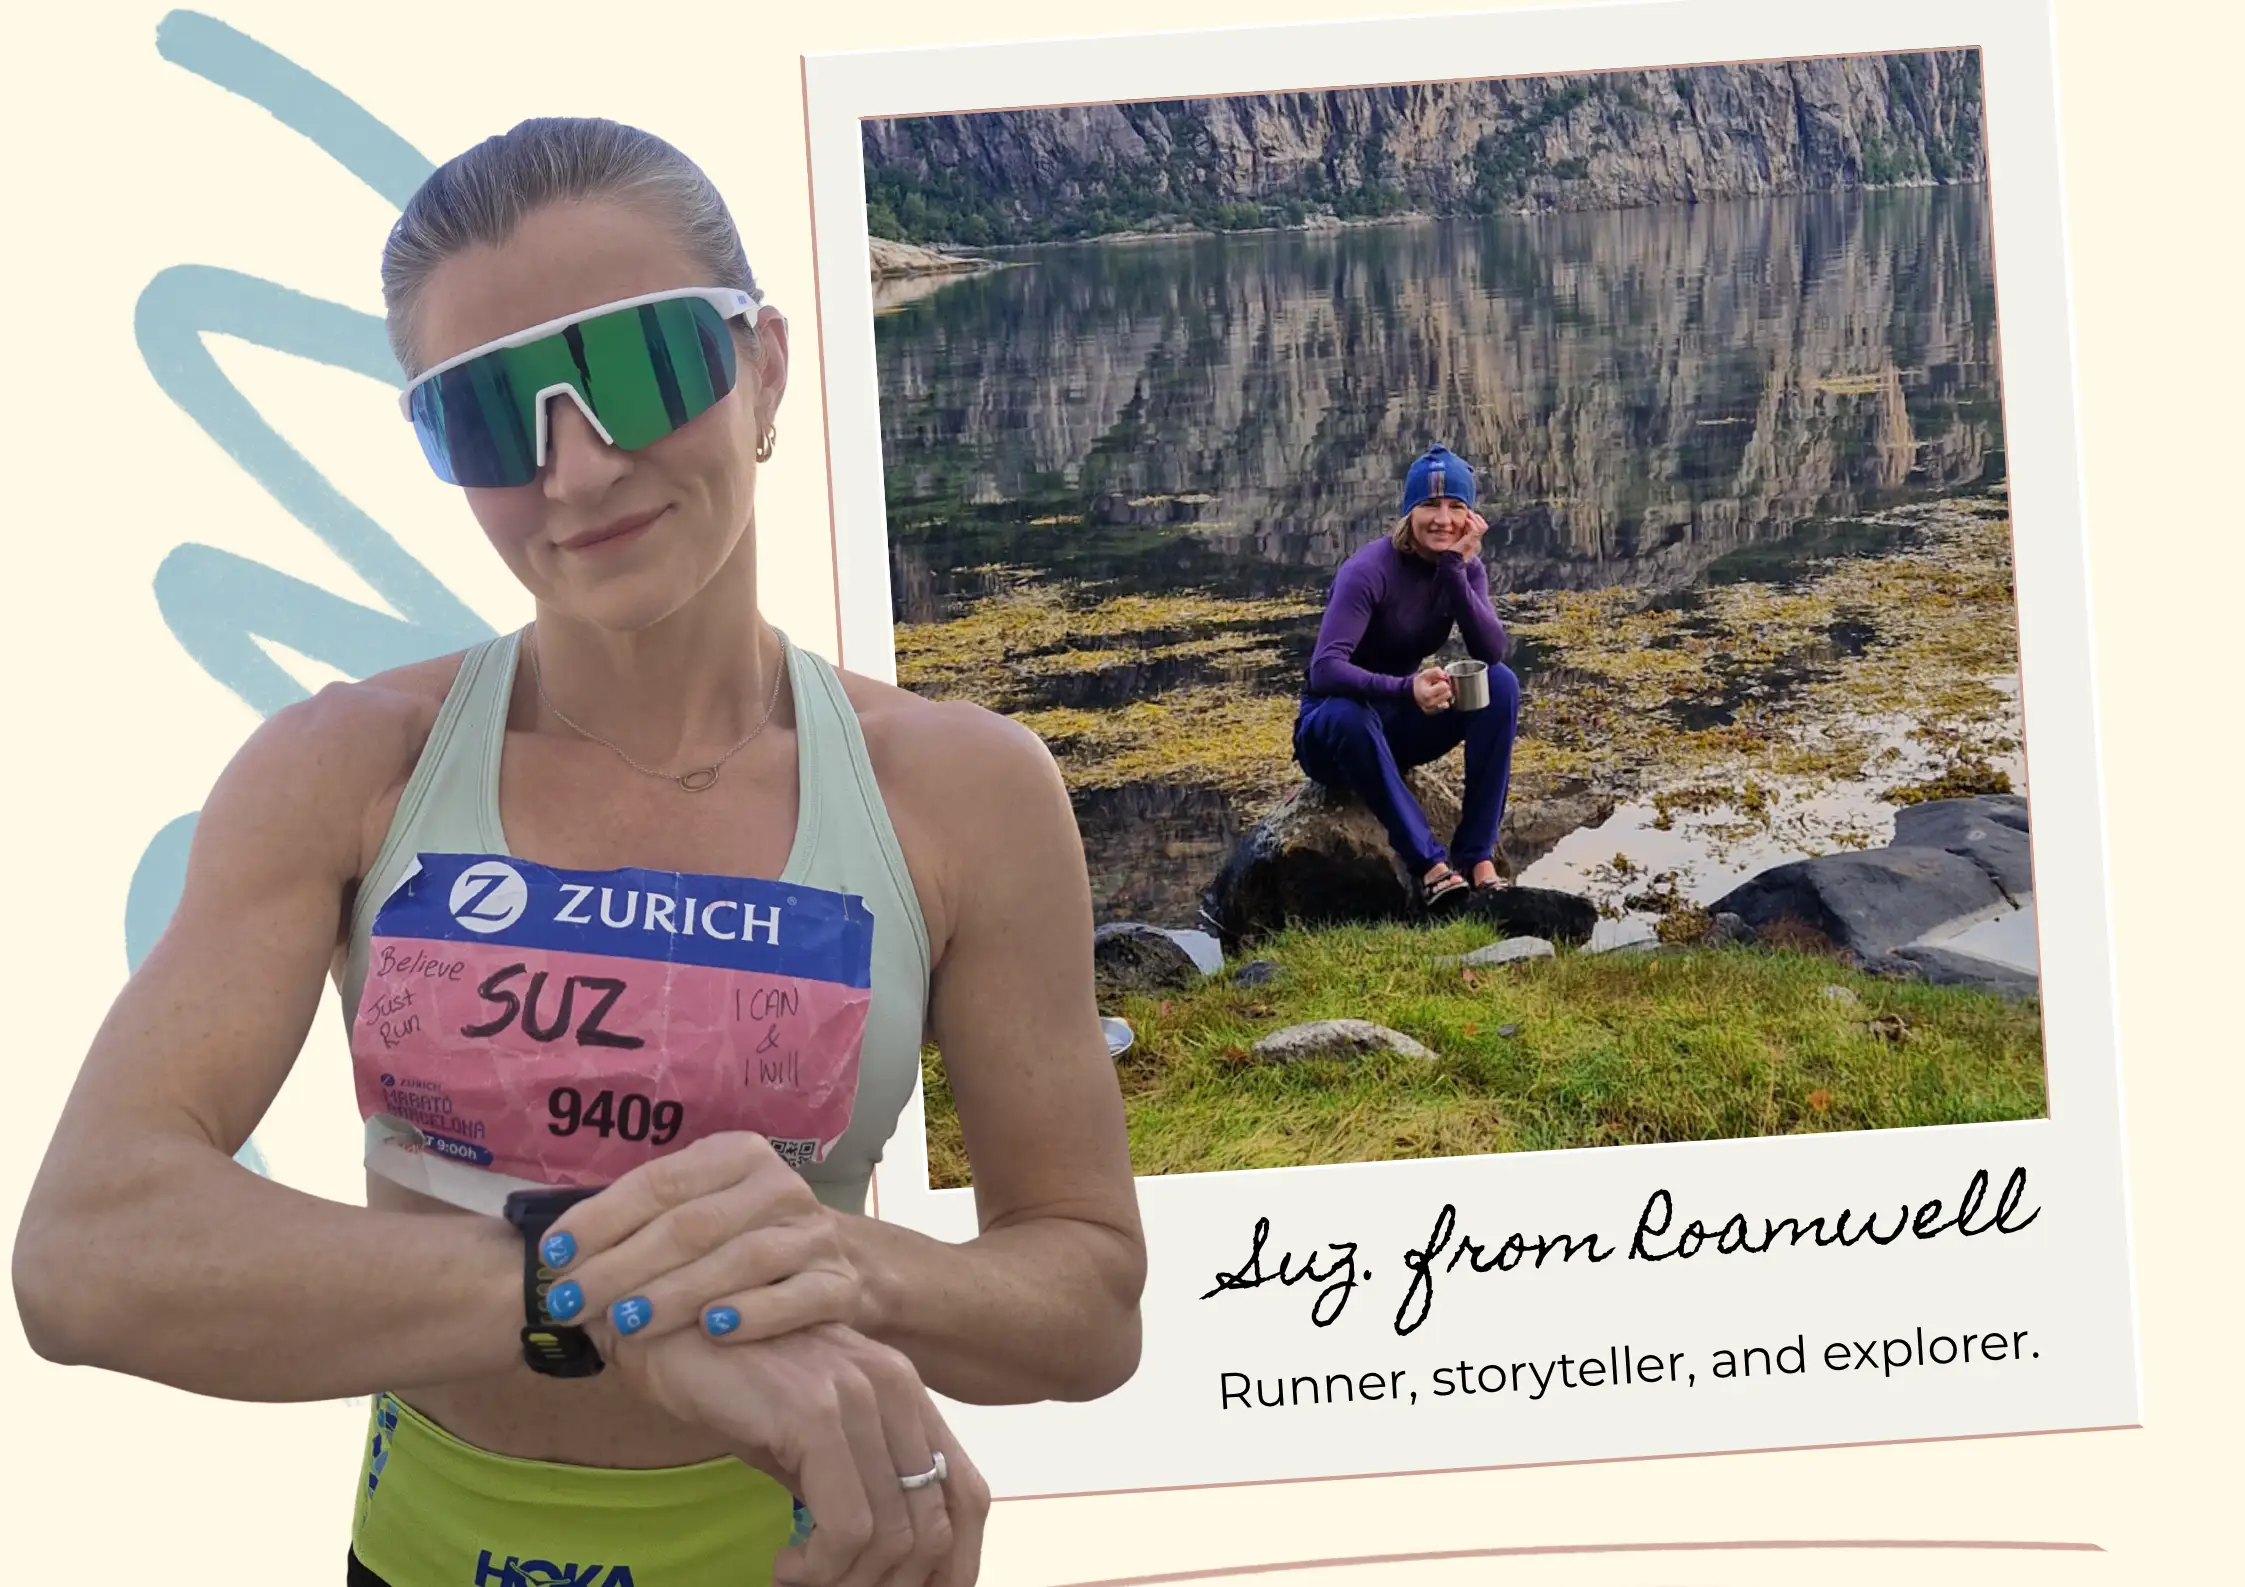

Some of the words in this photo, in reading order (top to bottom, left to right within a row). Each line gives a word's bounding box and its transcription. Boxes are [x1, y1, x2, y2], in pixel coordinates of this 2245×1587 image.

[554, 884, 782, 945] ZURICH
[377, 945, 465, 981] Believe
[366, 987, 417, 1026] Just
[460, 962, 645, 1051] SUZ
[736, 988, 741, 1022] I
[750, 987, 799, 1021] CAN
[380, 1014, 421, 1049] Run
[756, 1023, 781, 1053] &
[548, 1087, 684, 1147] 9409
[437, 1138, 477, 1161] 9:00h
